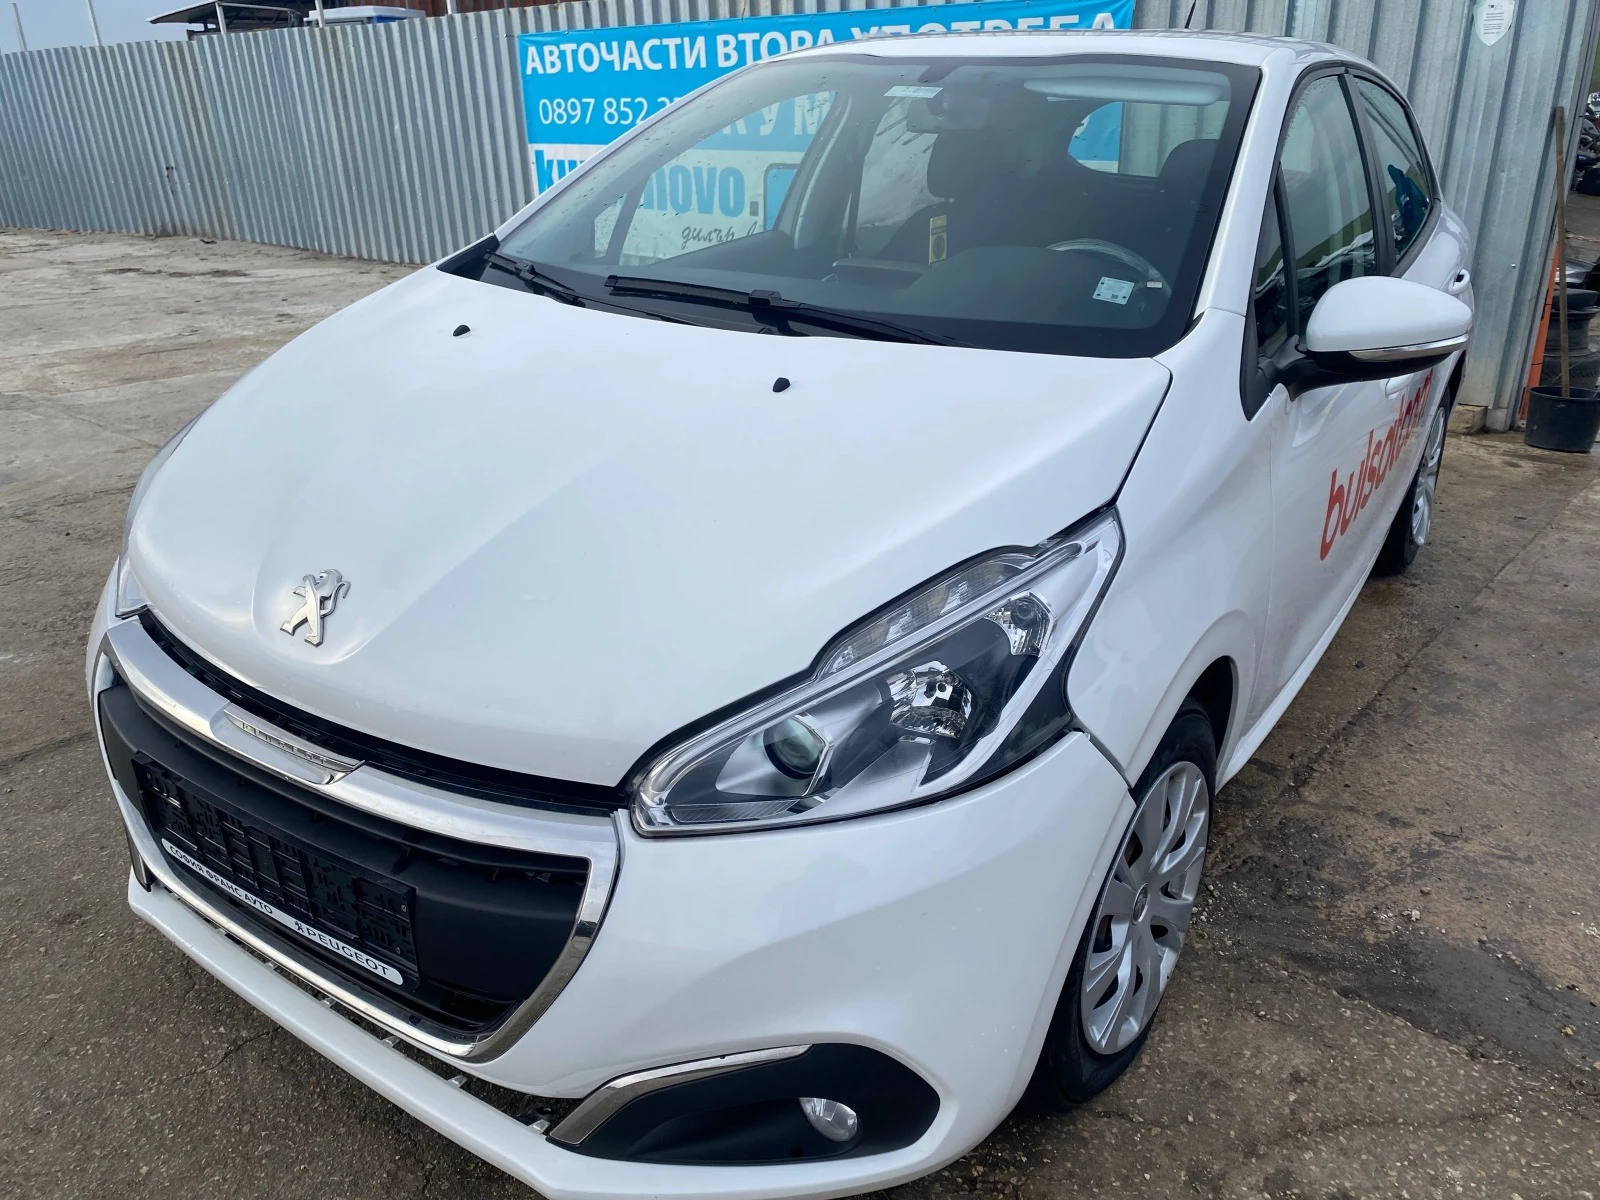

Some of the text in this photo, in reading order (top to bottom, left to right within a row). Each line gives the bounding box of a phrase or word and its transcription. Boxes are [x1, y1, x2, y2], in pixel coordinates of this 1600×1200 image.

[525, 36, 706, 75] АВТОЧАСТИ
[539, 97, 648, 125] 0897 852
[169, 845, 273, 915] СОФИЯ ФРАНС АУТО
[306, 927, 389, 976] PEUGEOT
